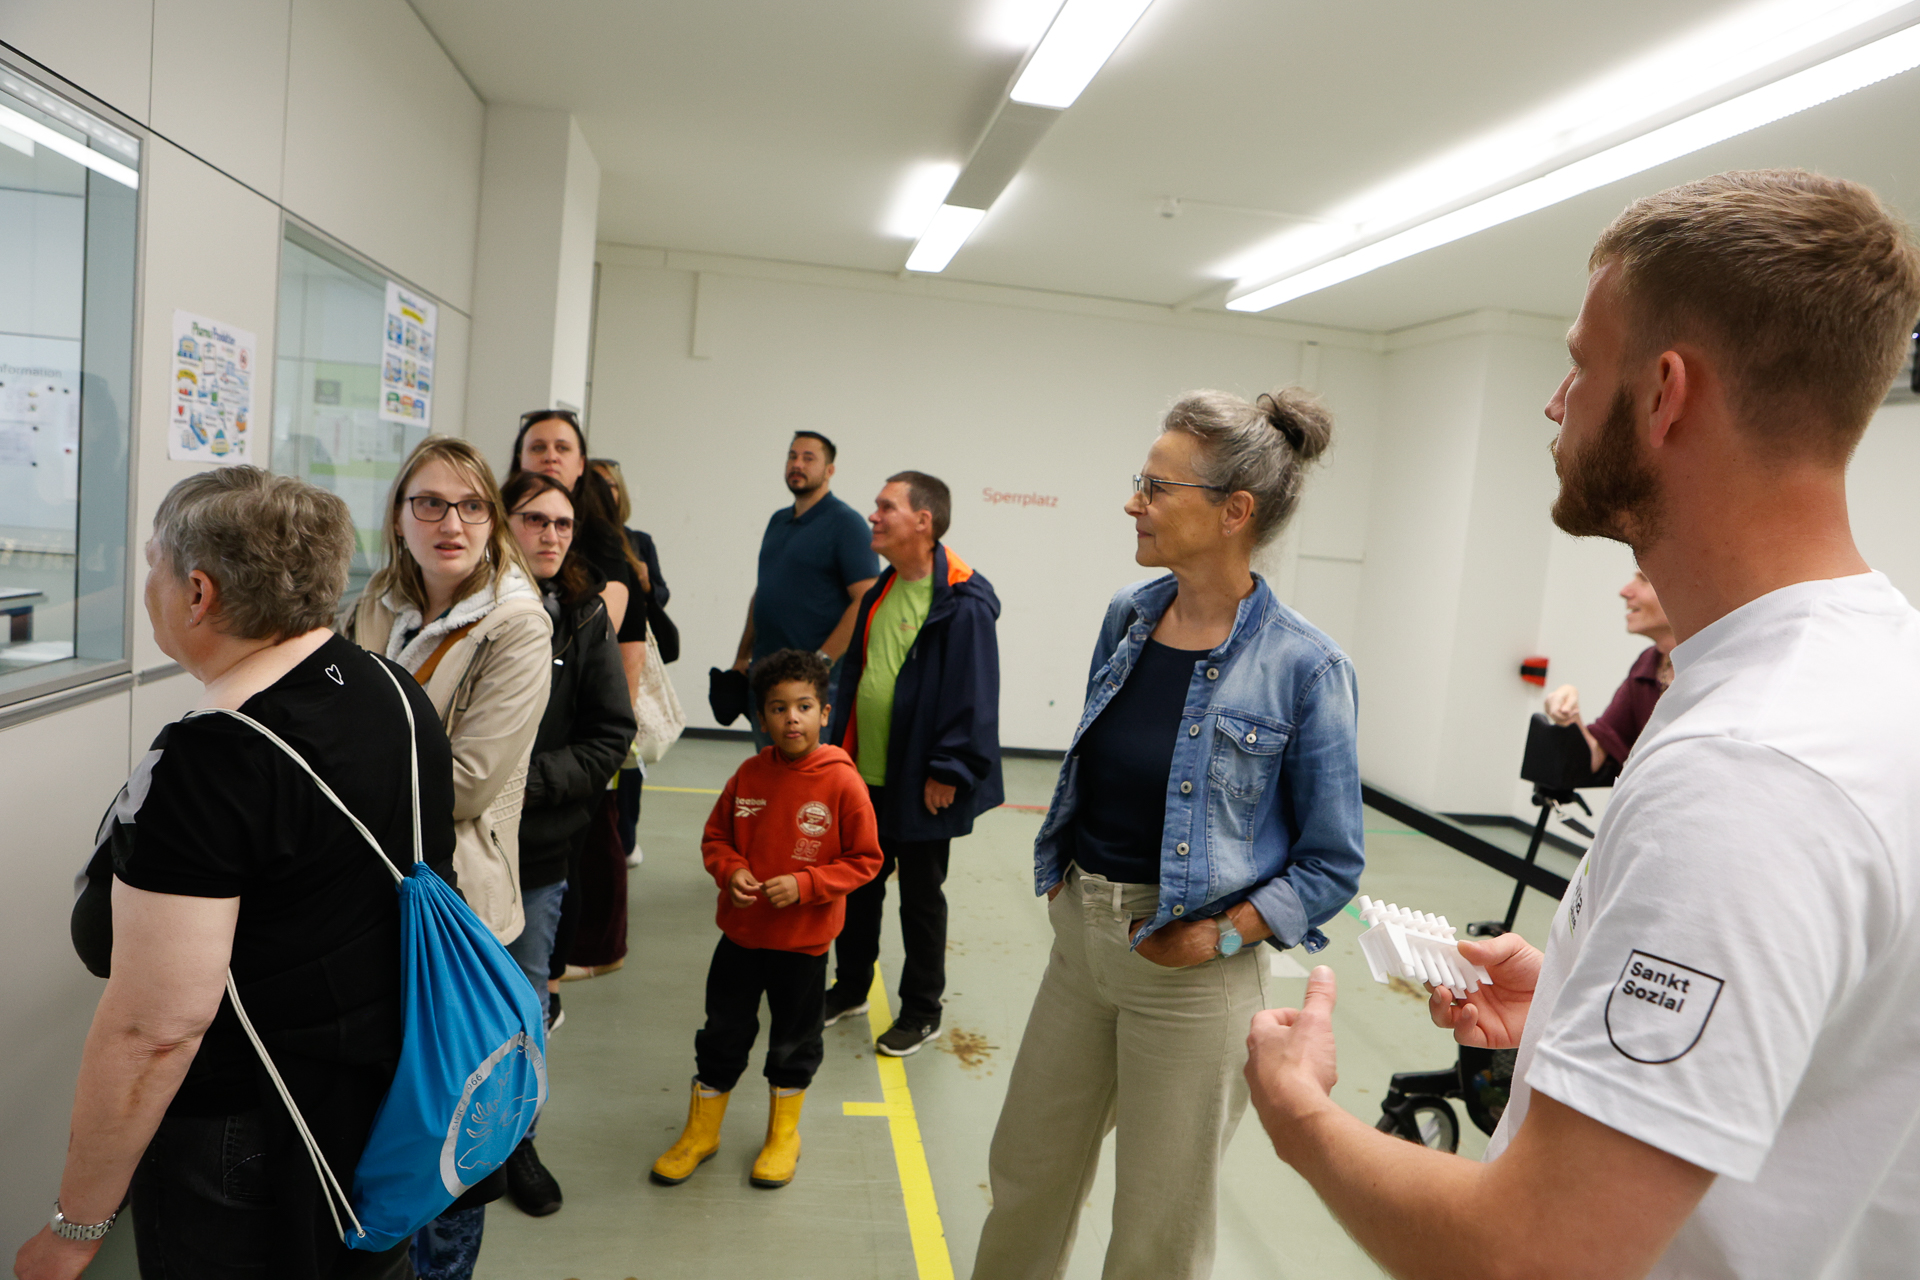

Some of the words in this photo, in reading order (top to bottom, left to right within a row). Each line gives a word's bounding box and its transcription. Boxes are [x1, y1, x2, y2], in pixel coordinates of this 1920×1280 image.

[982, 486, 1059, 508] Sperrplatz
[793, 838, 822, 858] 95
[1630, 961, 1690, 994] Sankt
[1622, 980, 1685, 1013] Sozial
[452, 1098, 469, 1131] SINCE
